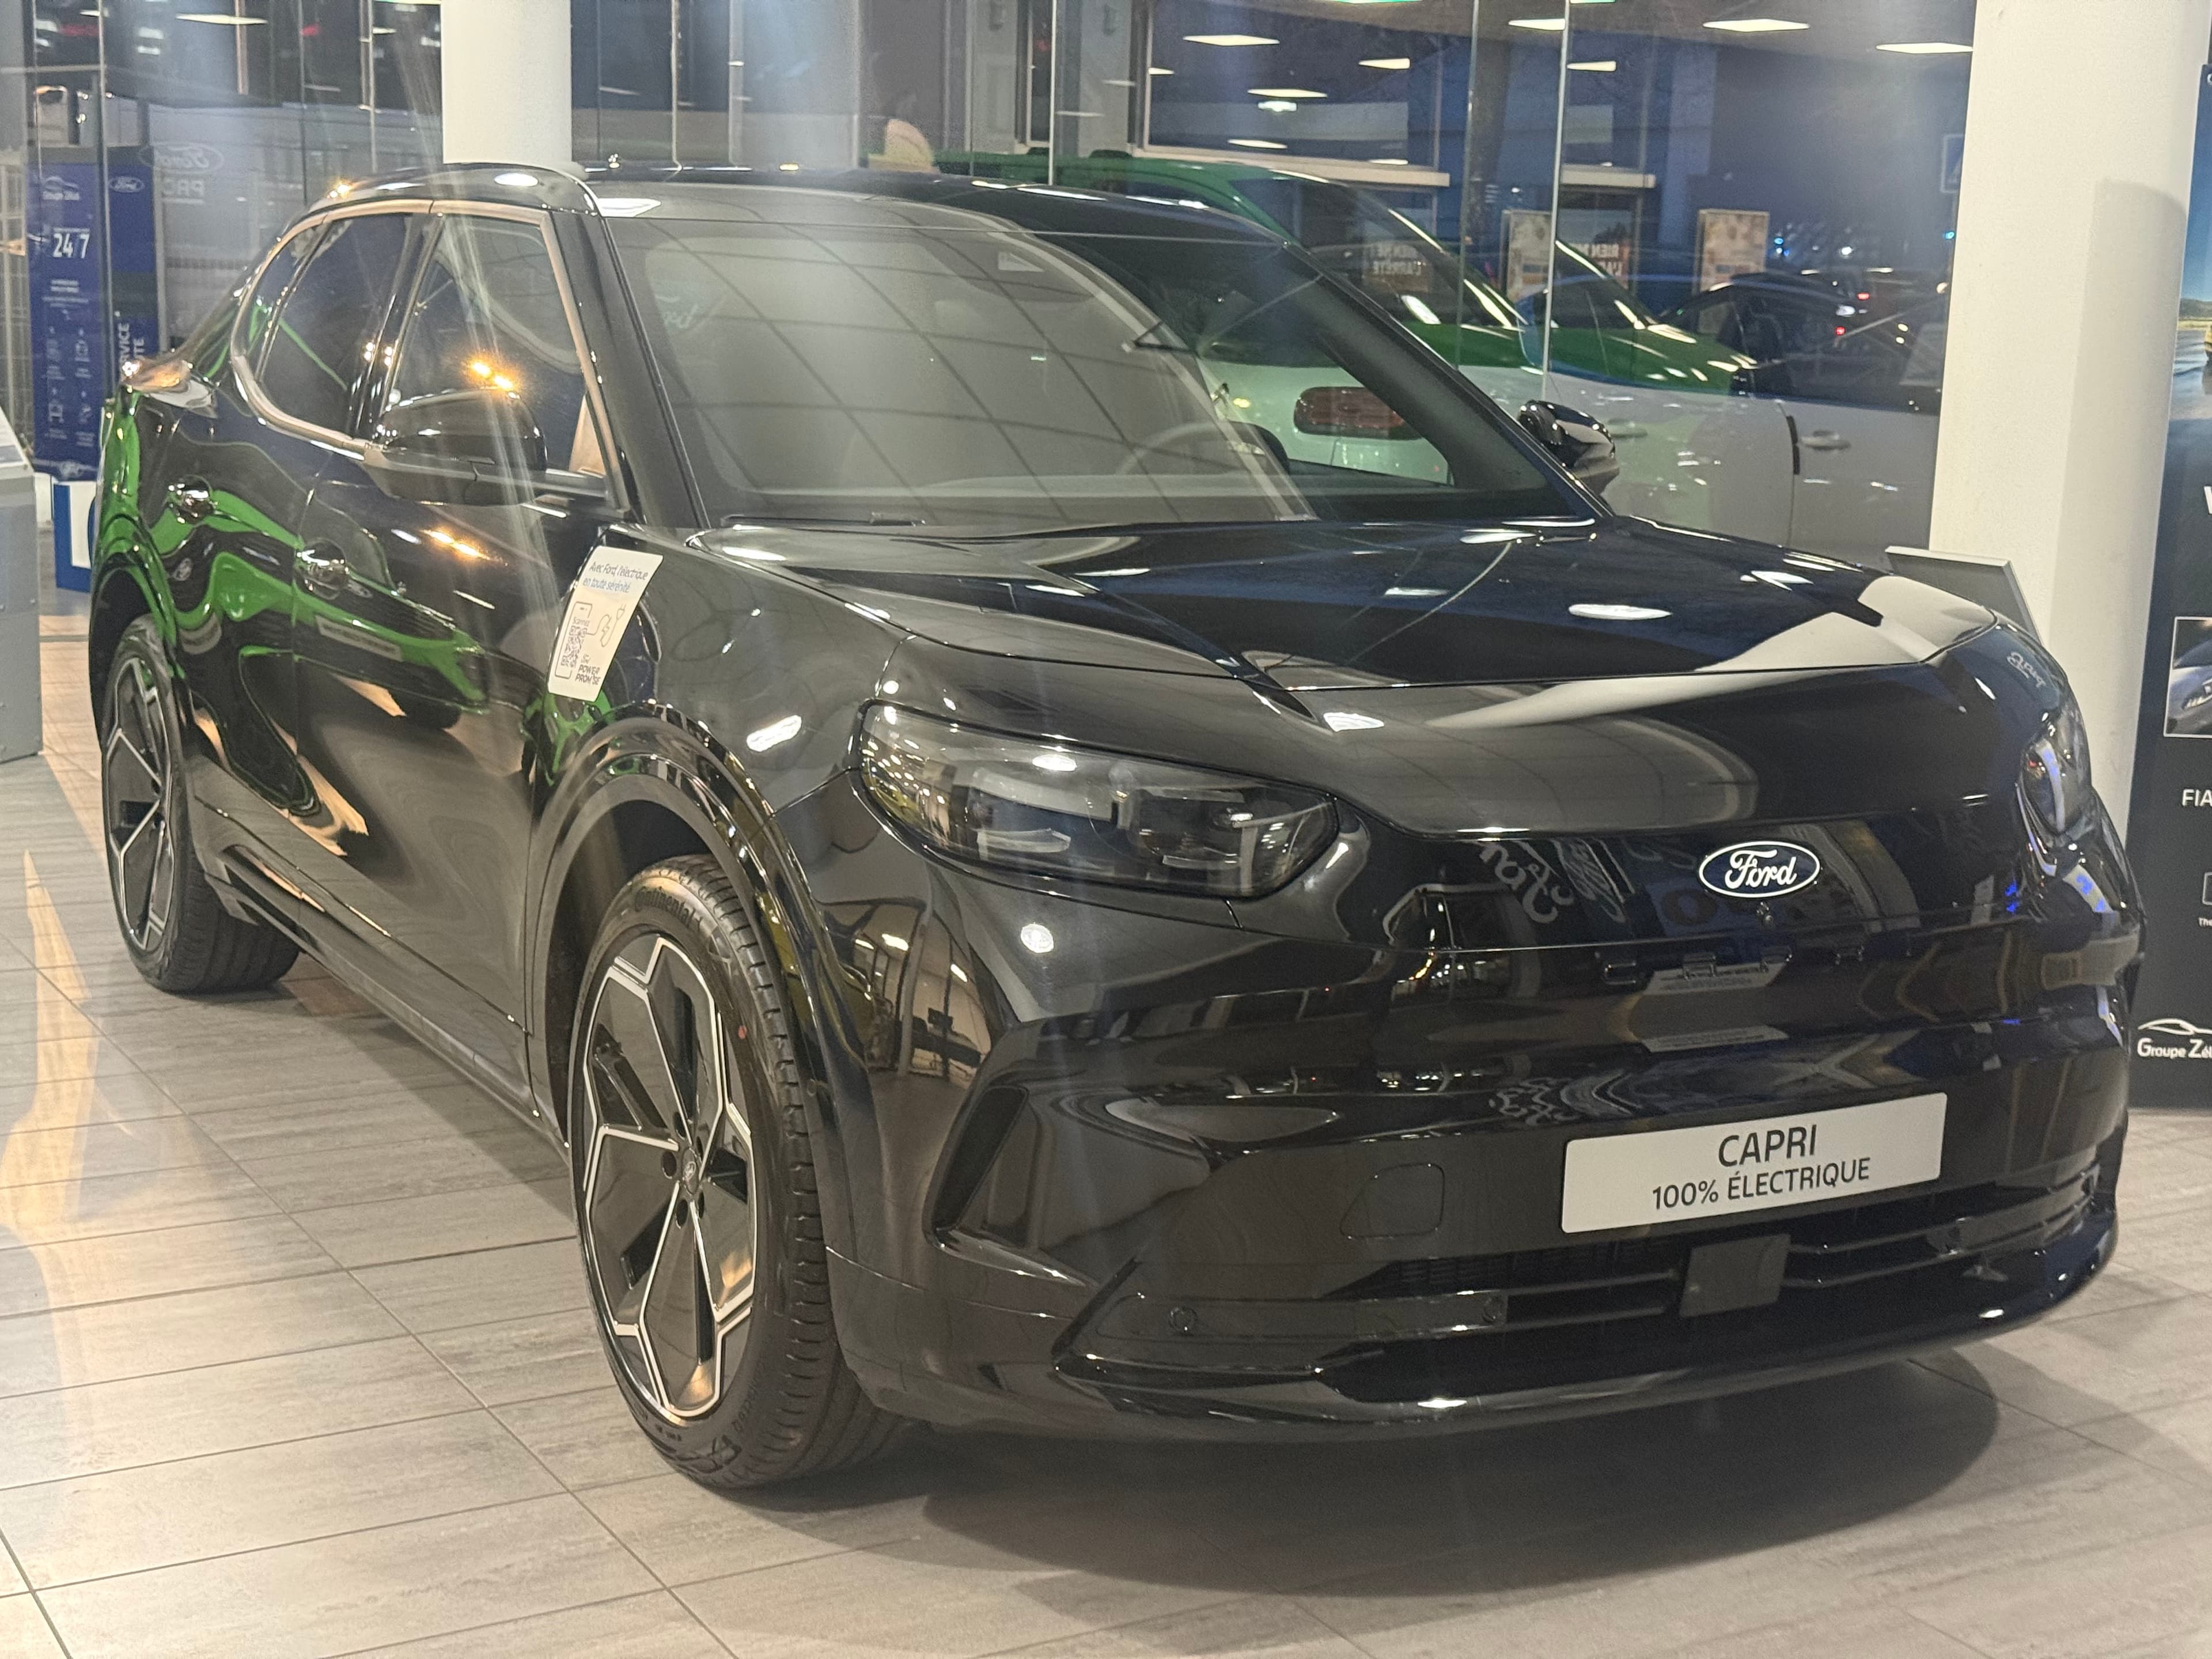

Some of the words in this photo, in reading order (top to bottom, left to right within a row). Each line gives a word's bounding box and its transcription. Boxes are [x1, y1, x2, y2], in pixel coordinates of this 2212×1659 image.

[575, 673, 601, 685] PROMISE
[578, 664, 600, 675] POWER
[1725, 849, 1797, 889] Ford
[634, 885, 696, 929] Continental
[2137, 1037, 2187, 1059] Groupe
[1718, 1124, 1817, 1168] CAPRI
[1652, 1179, 1719, 1210] 100%
[1728, 1157, 1871, 1200] ÉLECTRIQUE
